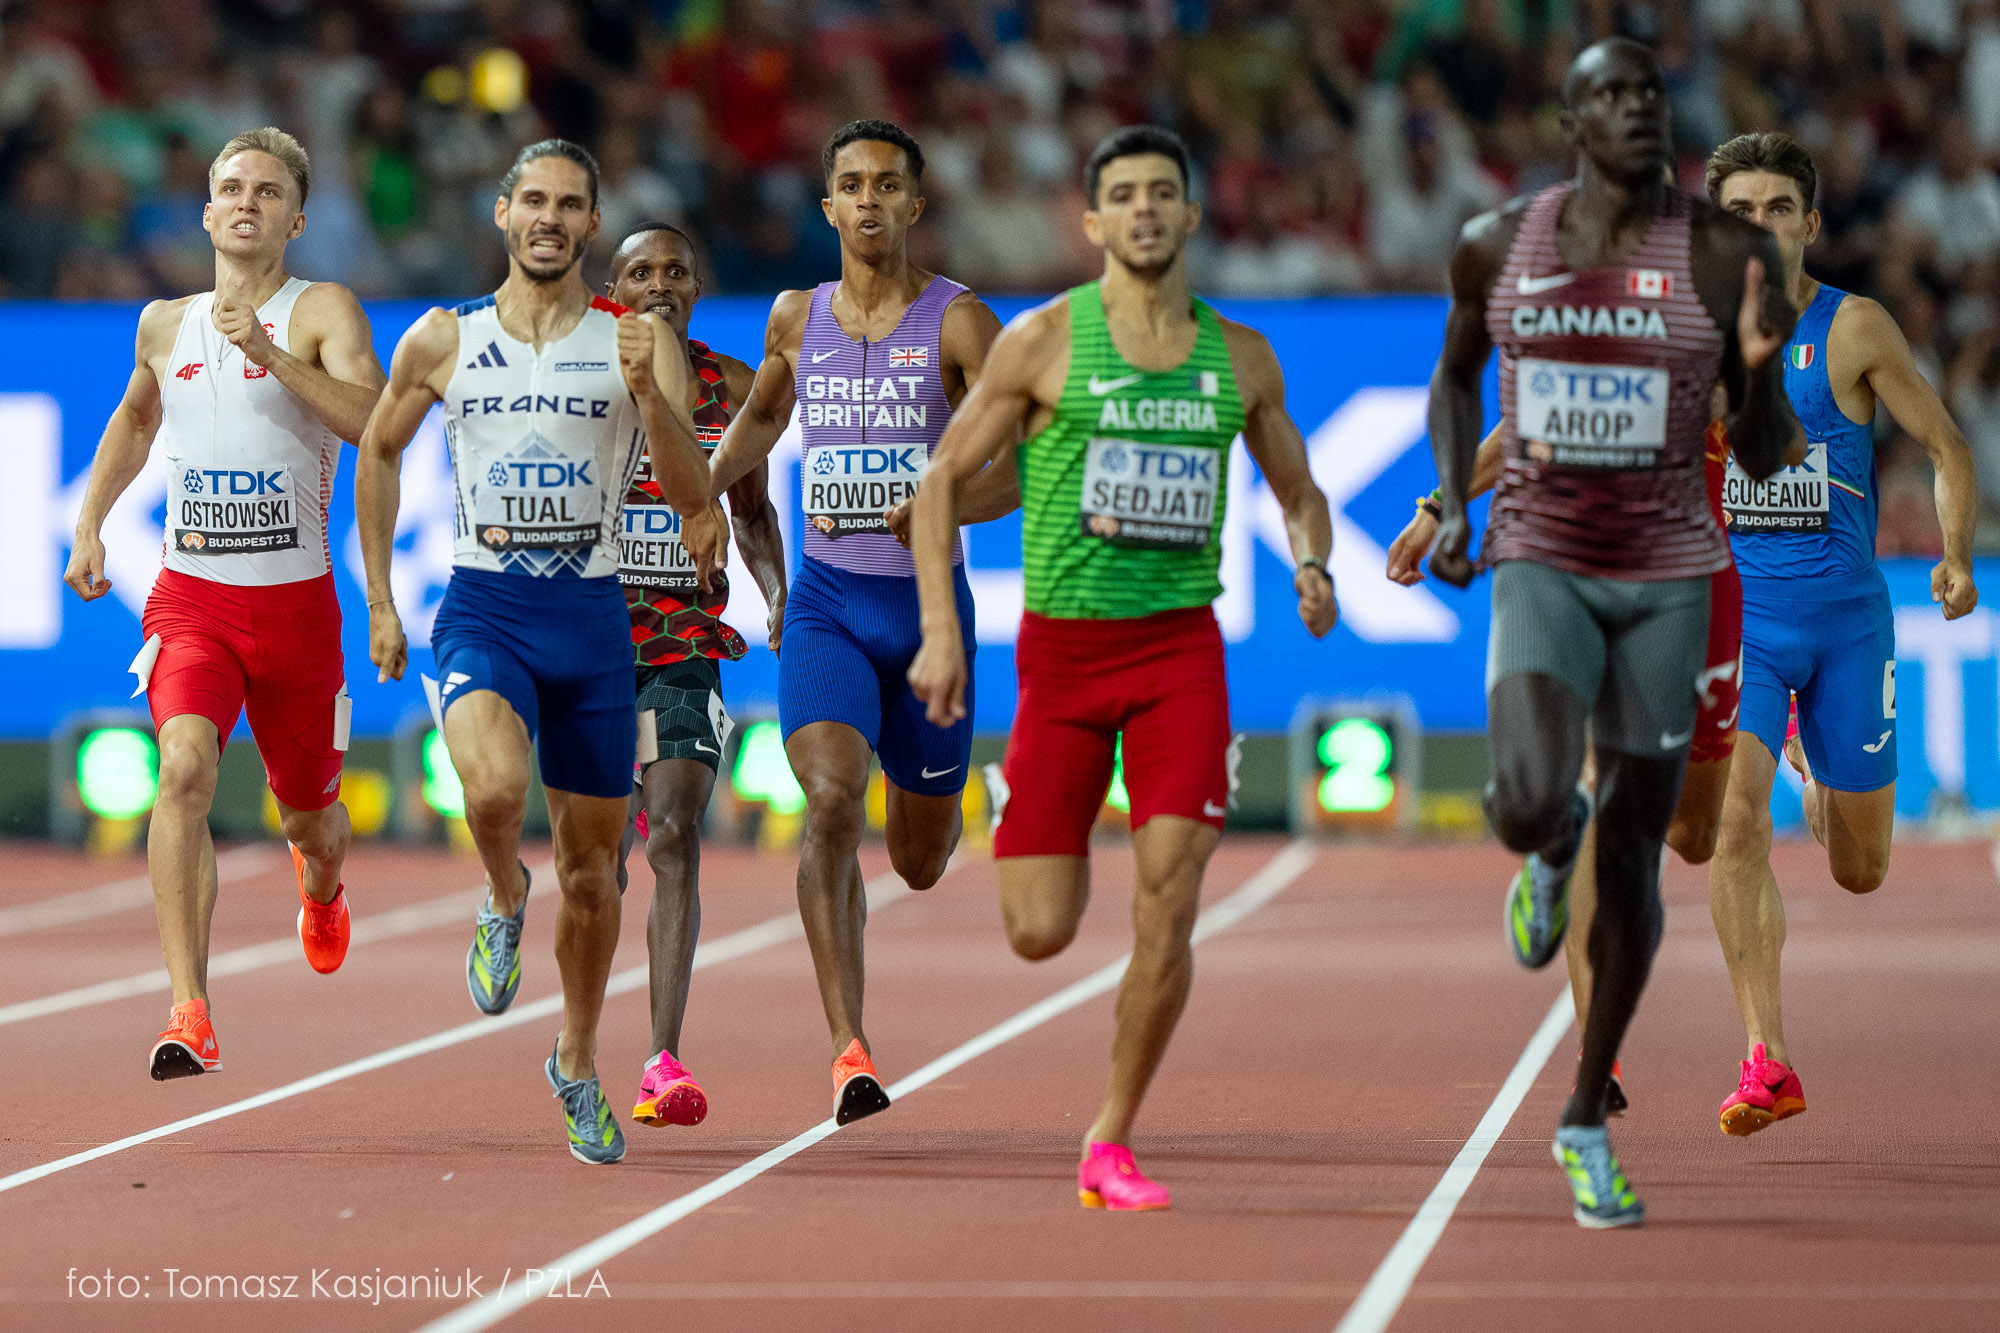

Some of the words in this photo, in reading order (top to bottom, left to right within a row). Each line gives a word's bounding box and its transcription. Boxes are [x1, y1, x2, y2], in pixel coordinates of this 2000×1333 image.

[1511, 305, 1667, 340] CANADA
[175, 363, 204, 380] 4F
[806, 375, 925, 401] GREAT
[1558, 369, 1652, 405] TDK
[462, 395, 609, 418] FRANCE
[808, 404, 926, 428] BRITAIN
[1100, 398, 1218, 432] ALGERIA
[1545, 407, 1634, 441] AROP
[509, 460, 593, 488] TDK
[836, 448, 919, 474] TDK
[1132, 449, 1212, 481] TDK
[203, 470, 286, 495] TDK
[501, 496, 575, 522] TUAL
[1093, 480, 1211, 519] SEDJATI
[182, 500, 290, 529] OSTROWSKI
[1737, 514, 1804, 527] BUDAPEST
[1807, 517, 1822, 526] 23
[208, 535, 274, 548] BUDAPEST
[276, 534, 291, 544] 23
[512, 531, 581, 543] BUDAPEST
[582, 529, 597, 540] 23
[617, 574, 683, 587] BUDAPEST
[685, 578, 698, 586] 23
